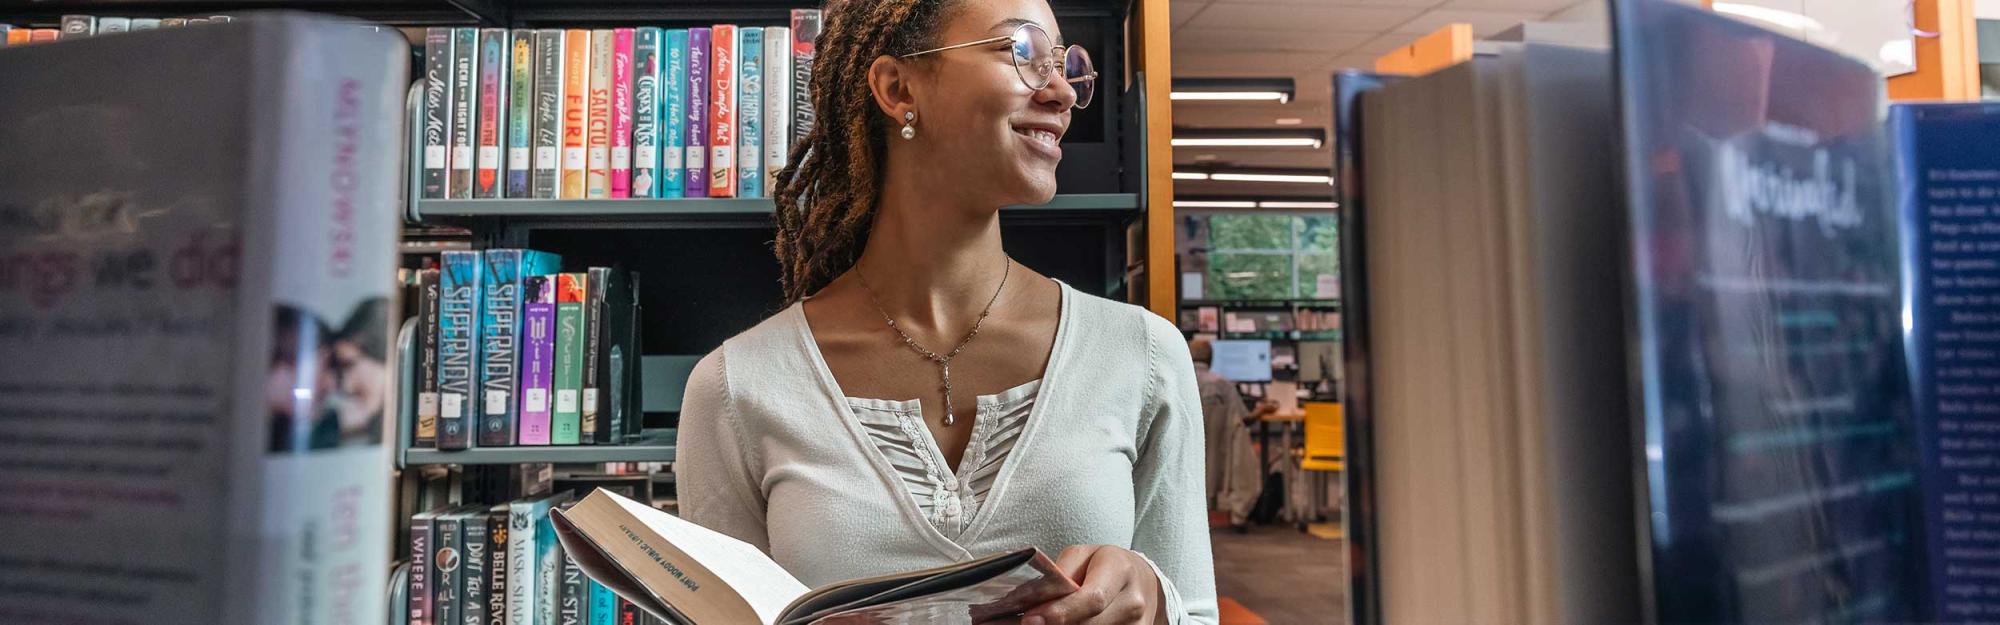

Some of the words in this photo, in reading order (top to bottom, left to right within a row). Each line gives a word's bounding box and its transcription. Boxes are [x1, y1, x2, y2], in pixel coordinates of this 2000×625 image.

[615, 53, 628, 80] From
[670, 48, 680, 57] 10
[691, 46, 703, 74] There's
[716, 47, 731, 75] When
[458, 57, 469, 87] LUCHA
[666, 59, 681, 91] Things
[769, 66, 781, 107] Beauty's
[427, 70, 445, 109] Miss
[637, 75, 656, 114] CURSES
[688, 76, 702, 121] Something
[713, 79, 729, 119] Dimple
[457, 102, 468, 129] NIGHT
[539, 91, 557, 123] People
[565, 95, 582, 147] FURI
[427, 109, 443, 147] Mete
[540, 128, 554, 147] Lik
[590, 89, 608, 176] SANCTUY
[634, 123, 656, 147] KISS
[716, 122, 729, 143] Met
[769, 110, 780, 146] Daught
[442, 286, 472, 400] SUPERNOV
[485, 284, 514, 400] SUPERNOV
[619, 524, 641, 546] LIBRARY
[412, 536, 425, 590] WHERE
[492, 551, 505, 590] BELLE
[513, 539, 526, 574] MASK
[641, 544, 661, 566] PUBLIC
[660, 559, 683, 581] MOODY
[467, 576, 483, 598] TELL
[681, 575, 699, 592] PORT
